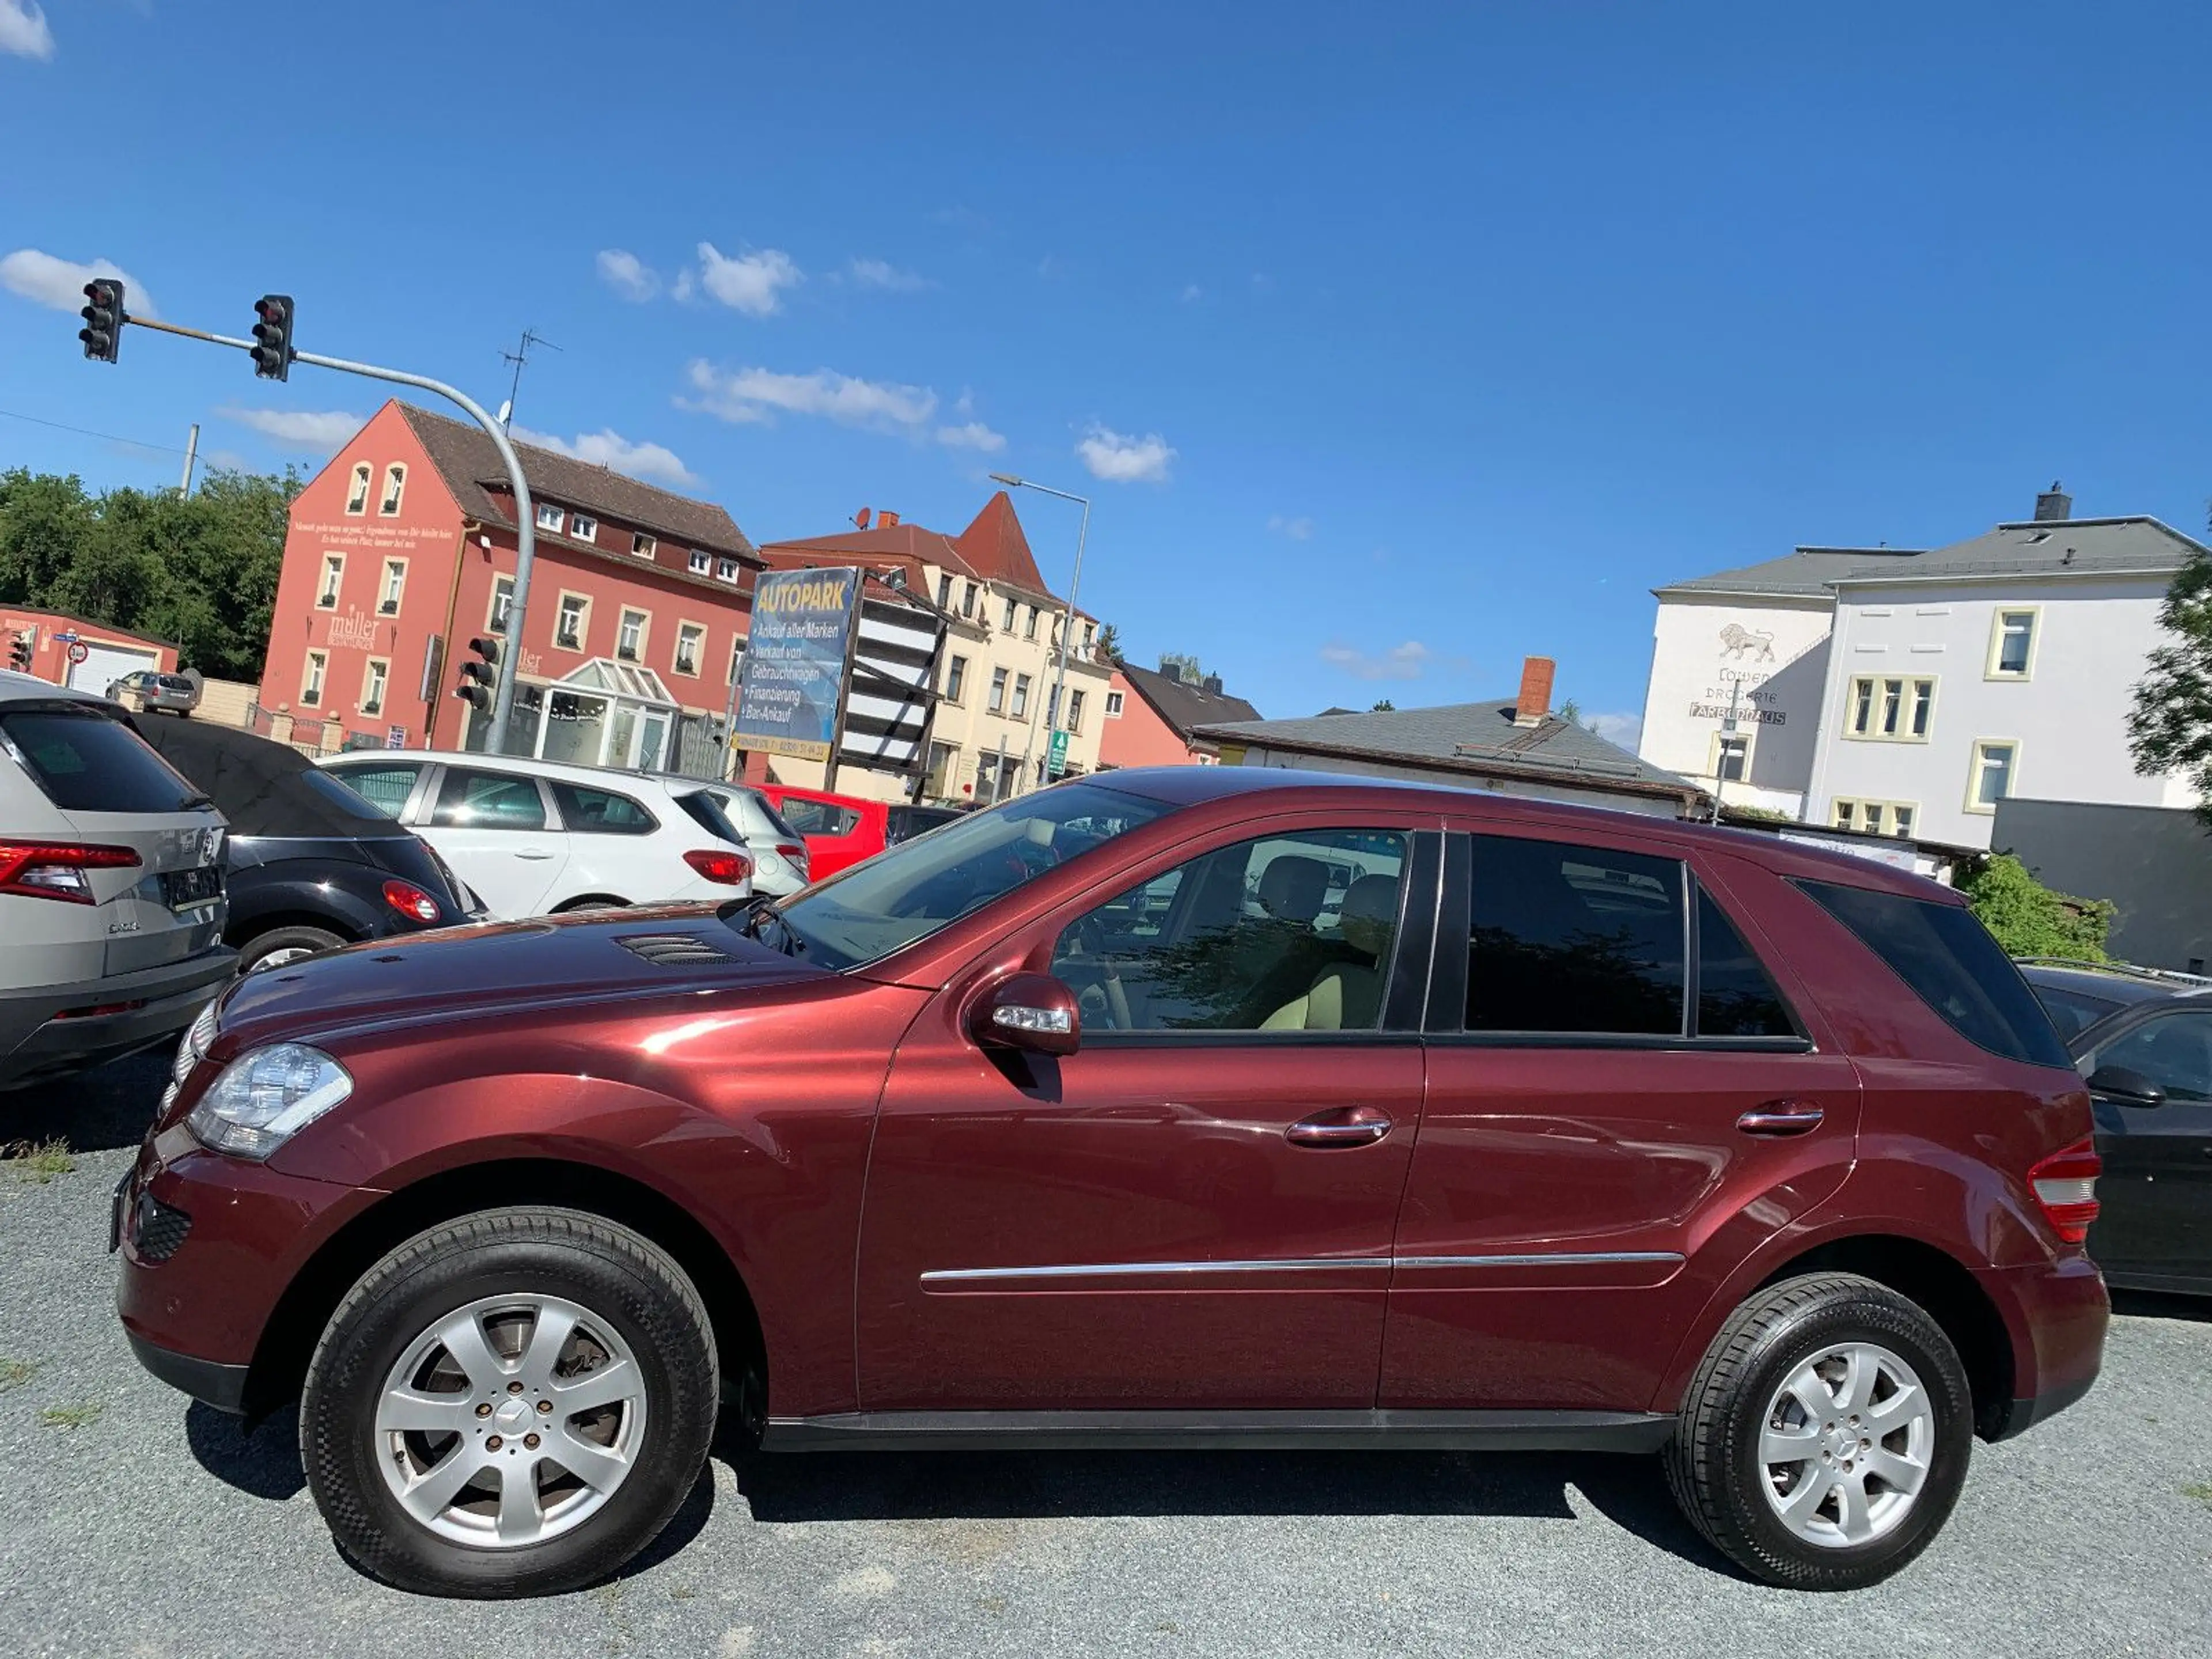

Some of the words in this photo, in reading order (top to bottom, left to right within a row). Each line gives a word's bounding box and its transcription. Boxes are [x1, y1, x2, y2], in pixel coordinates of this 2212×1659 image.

[756, 581, 846, 613] AUTOPARK
[757, 622, 786, 639] Ankauf
[786, 623, 805, 638] aller
[806, 622, 839, 639] Marken
[749, 684, 801, 707] Finanzierung
[745, 703, 791, 723] Bar-Ankauf
[1690, 702, 1786, 725] FARBNHAUS
